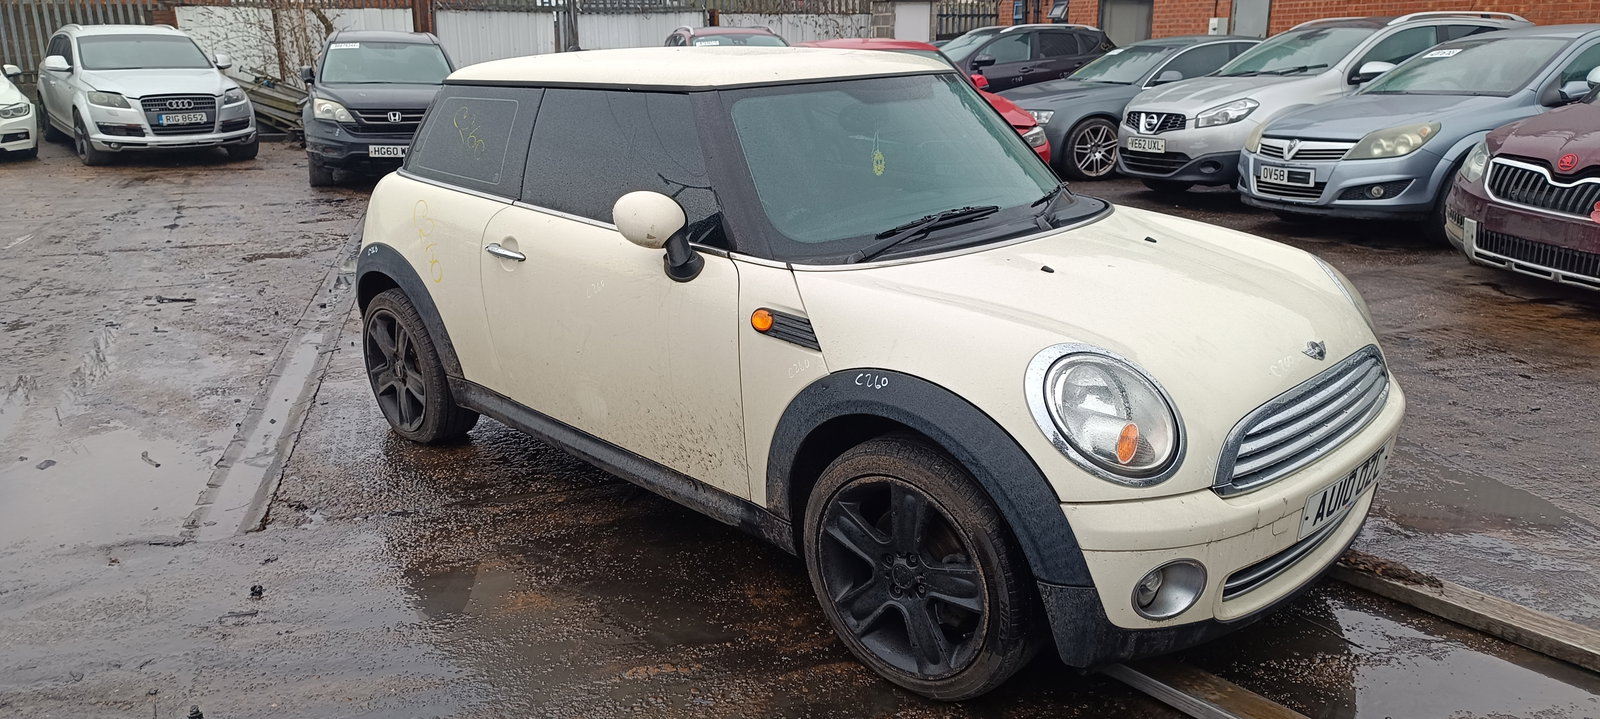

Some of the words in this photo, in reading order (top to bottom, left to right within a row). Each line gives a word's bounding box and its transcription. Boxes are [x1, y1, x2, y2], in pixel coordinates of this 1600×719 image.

[165, 115, 180, 123] RIG
[181, 113, 204, 122] 8652
[1130, 138, 1147, 150] YE62
[1147, 140, 1162, 151] UXL
[373, 147, 399, 156] HG60
[1263, 167, 1285, 181] OV58
[854, 373, 889, 390] C260
[1312, 472, 1358, 527] AU10
